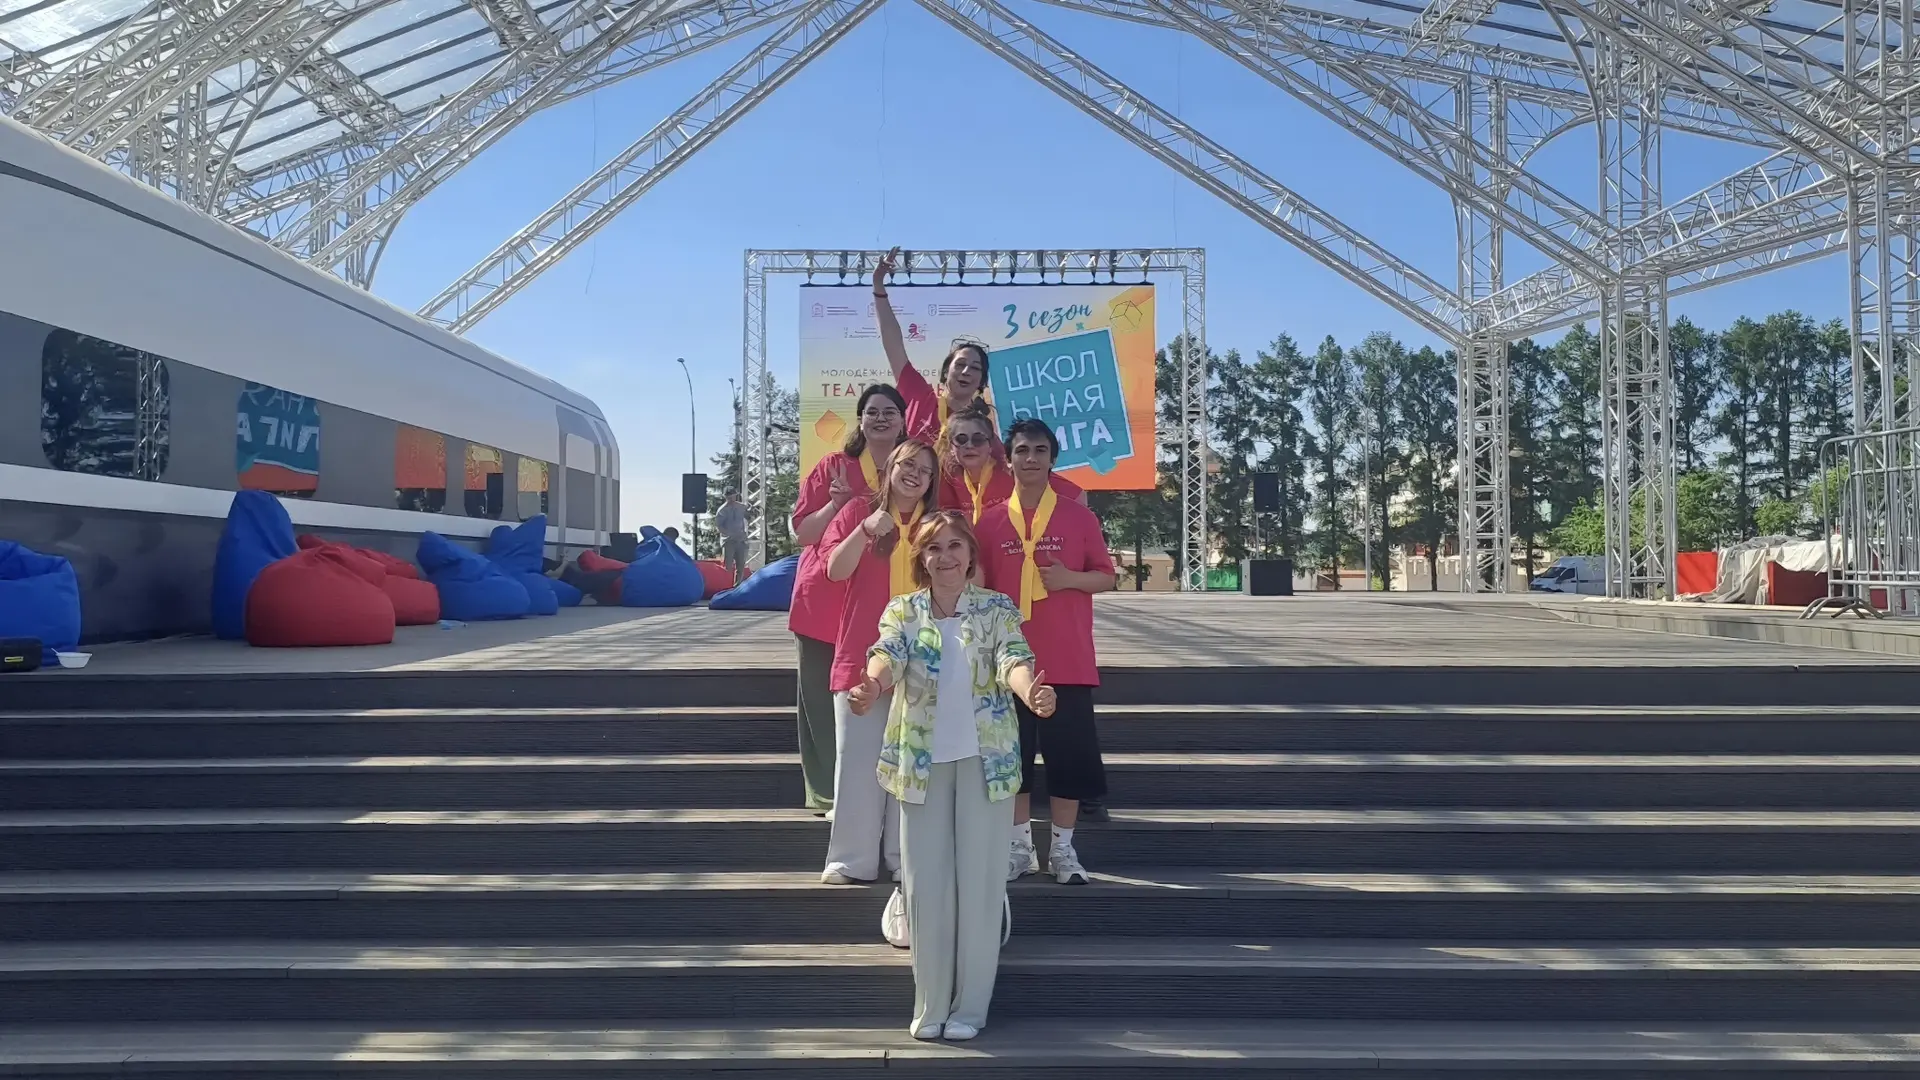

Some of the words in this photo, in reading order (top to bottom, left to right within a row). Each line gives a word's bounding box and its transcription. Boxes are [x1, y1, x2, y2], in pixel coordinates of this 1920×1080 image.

[1002, 303, 1020, 339] 3
[1028, 303, 1093, 334] сезон
[1004, 350, 1100, 392] ШКОЛ
[1054, 418, 1114, 451] ИГА
